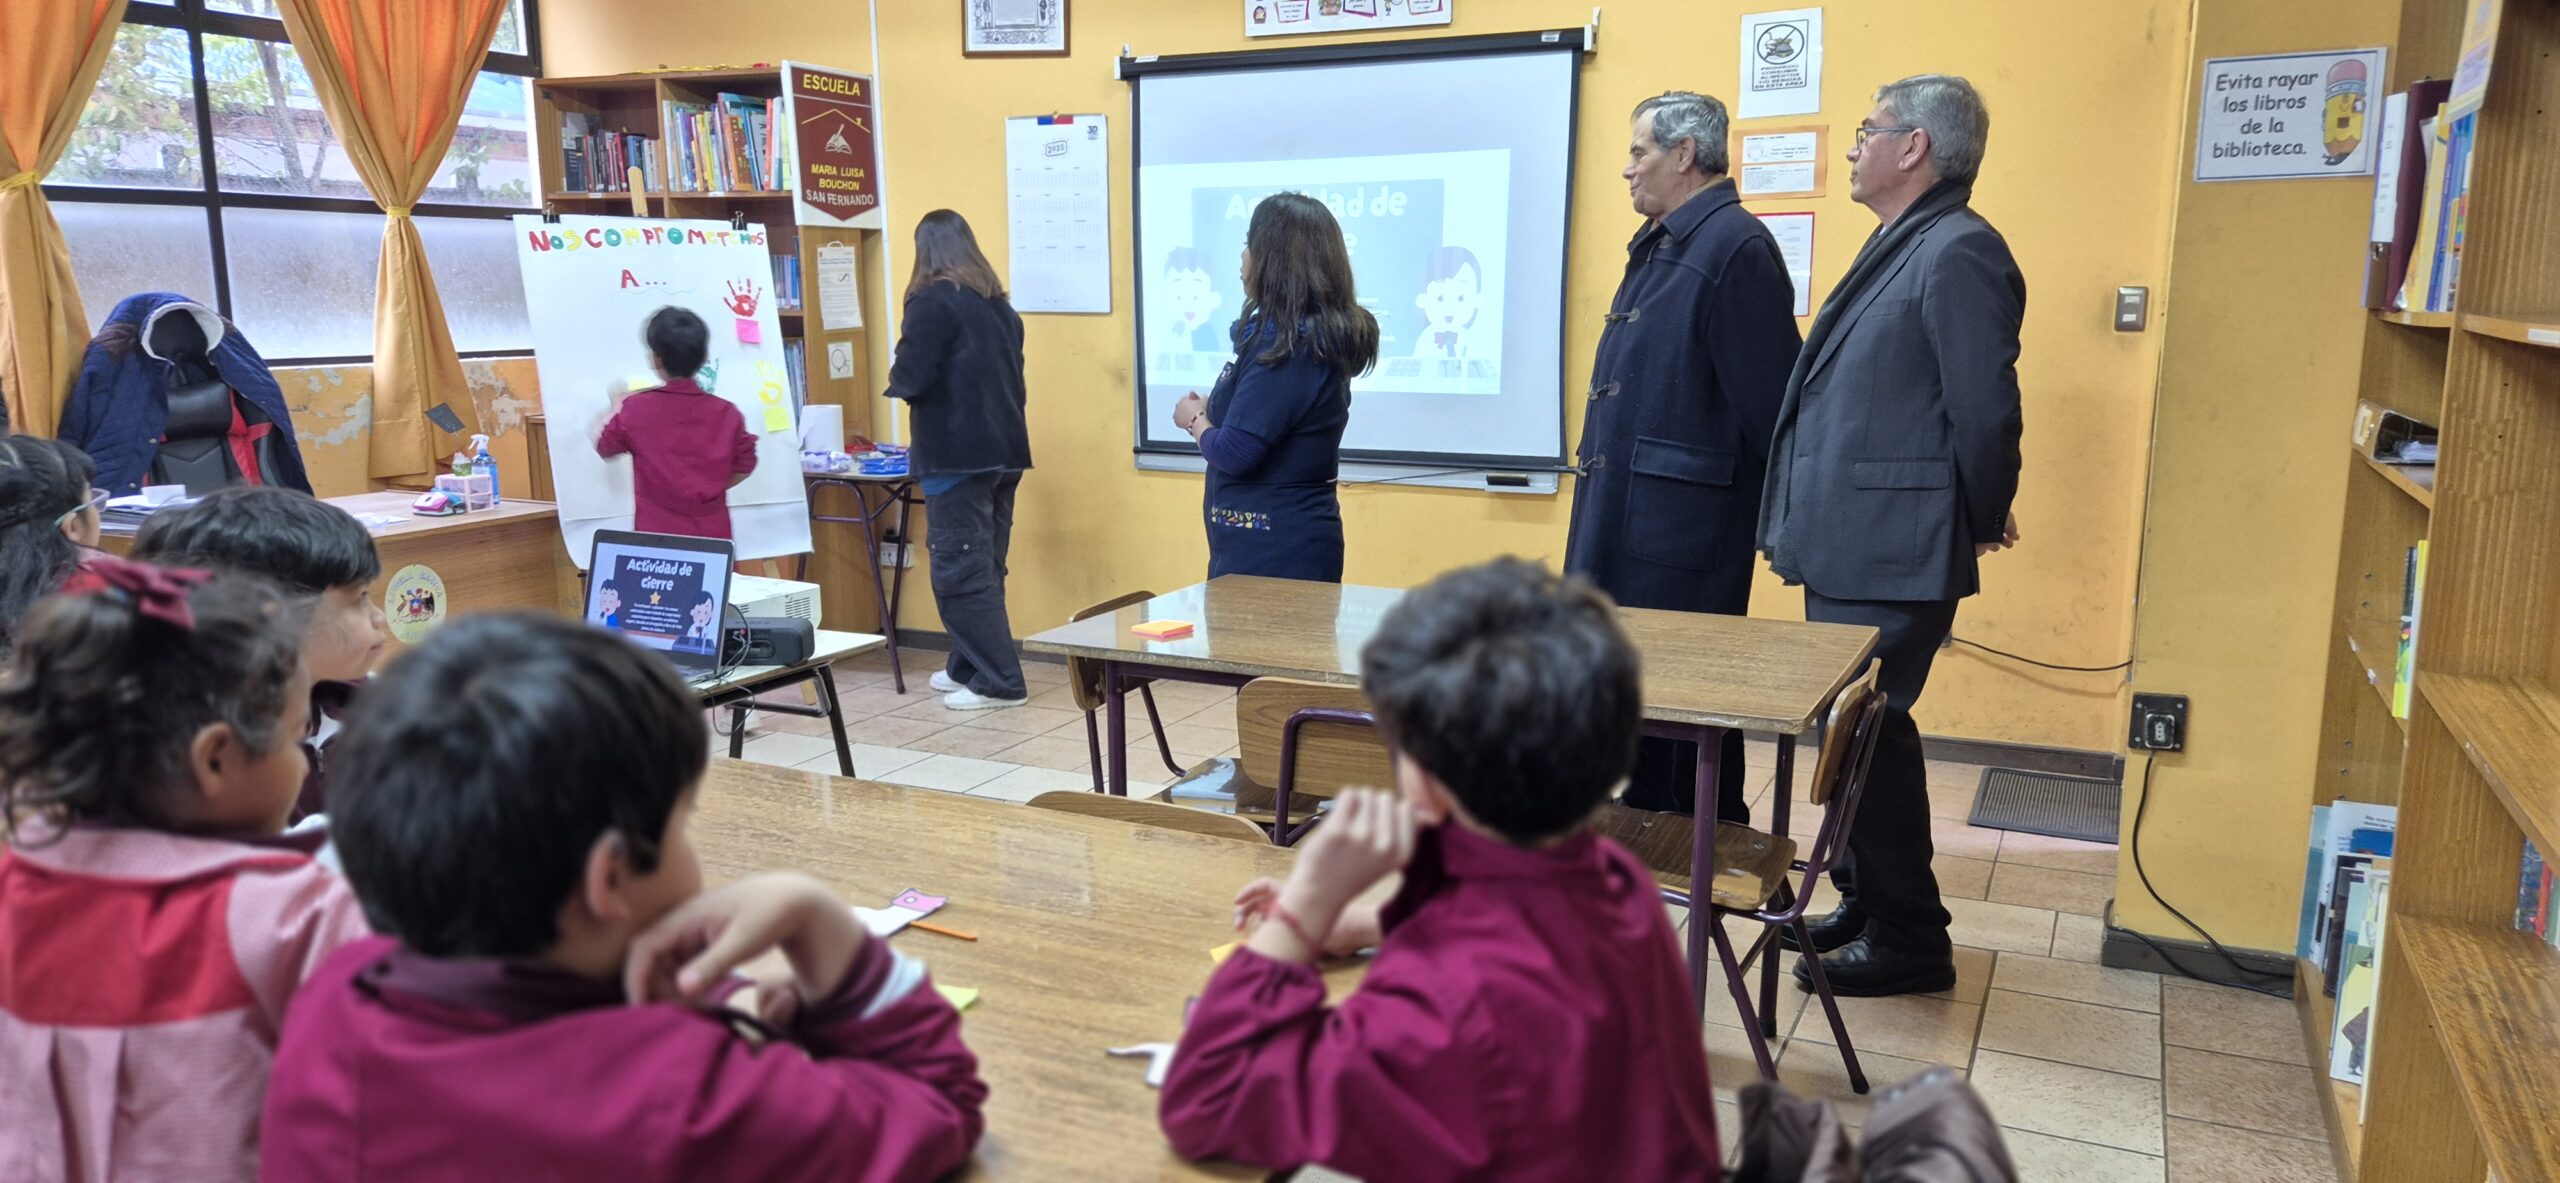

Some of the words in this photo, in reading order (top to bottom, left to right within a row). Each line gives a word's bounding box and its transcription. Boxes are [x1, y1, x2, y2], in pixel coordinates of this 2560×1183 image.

[803, 74, 860, 96] ESCUELA
[2215, 74, 2262, 91] Evita
[2268, 73, 2319, 91] rayar
[2223, 96, 2248, 113] los
[2254, 94, 2307, 111] libros
[2240, 118, 2262, 134] de
[2268, 116, 2284, 133] la
[2212, 140, 2307, 158] biblioteca.
[811, 164, 838, 176] MARIA
[840, 166, 864, 178] LUISA
[819, 178, 860, 191] BOUCHON
[806, 189, 826, 204] SAN
[827, 193, 874, 206] FERNANDO
[1370, 184, 1408, 217] de
[626, 558, 678, 576] Actividad
[679, 562, 693, 576] de
[640, 576, 674, 591] cierre
